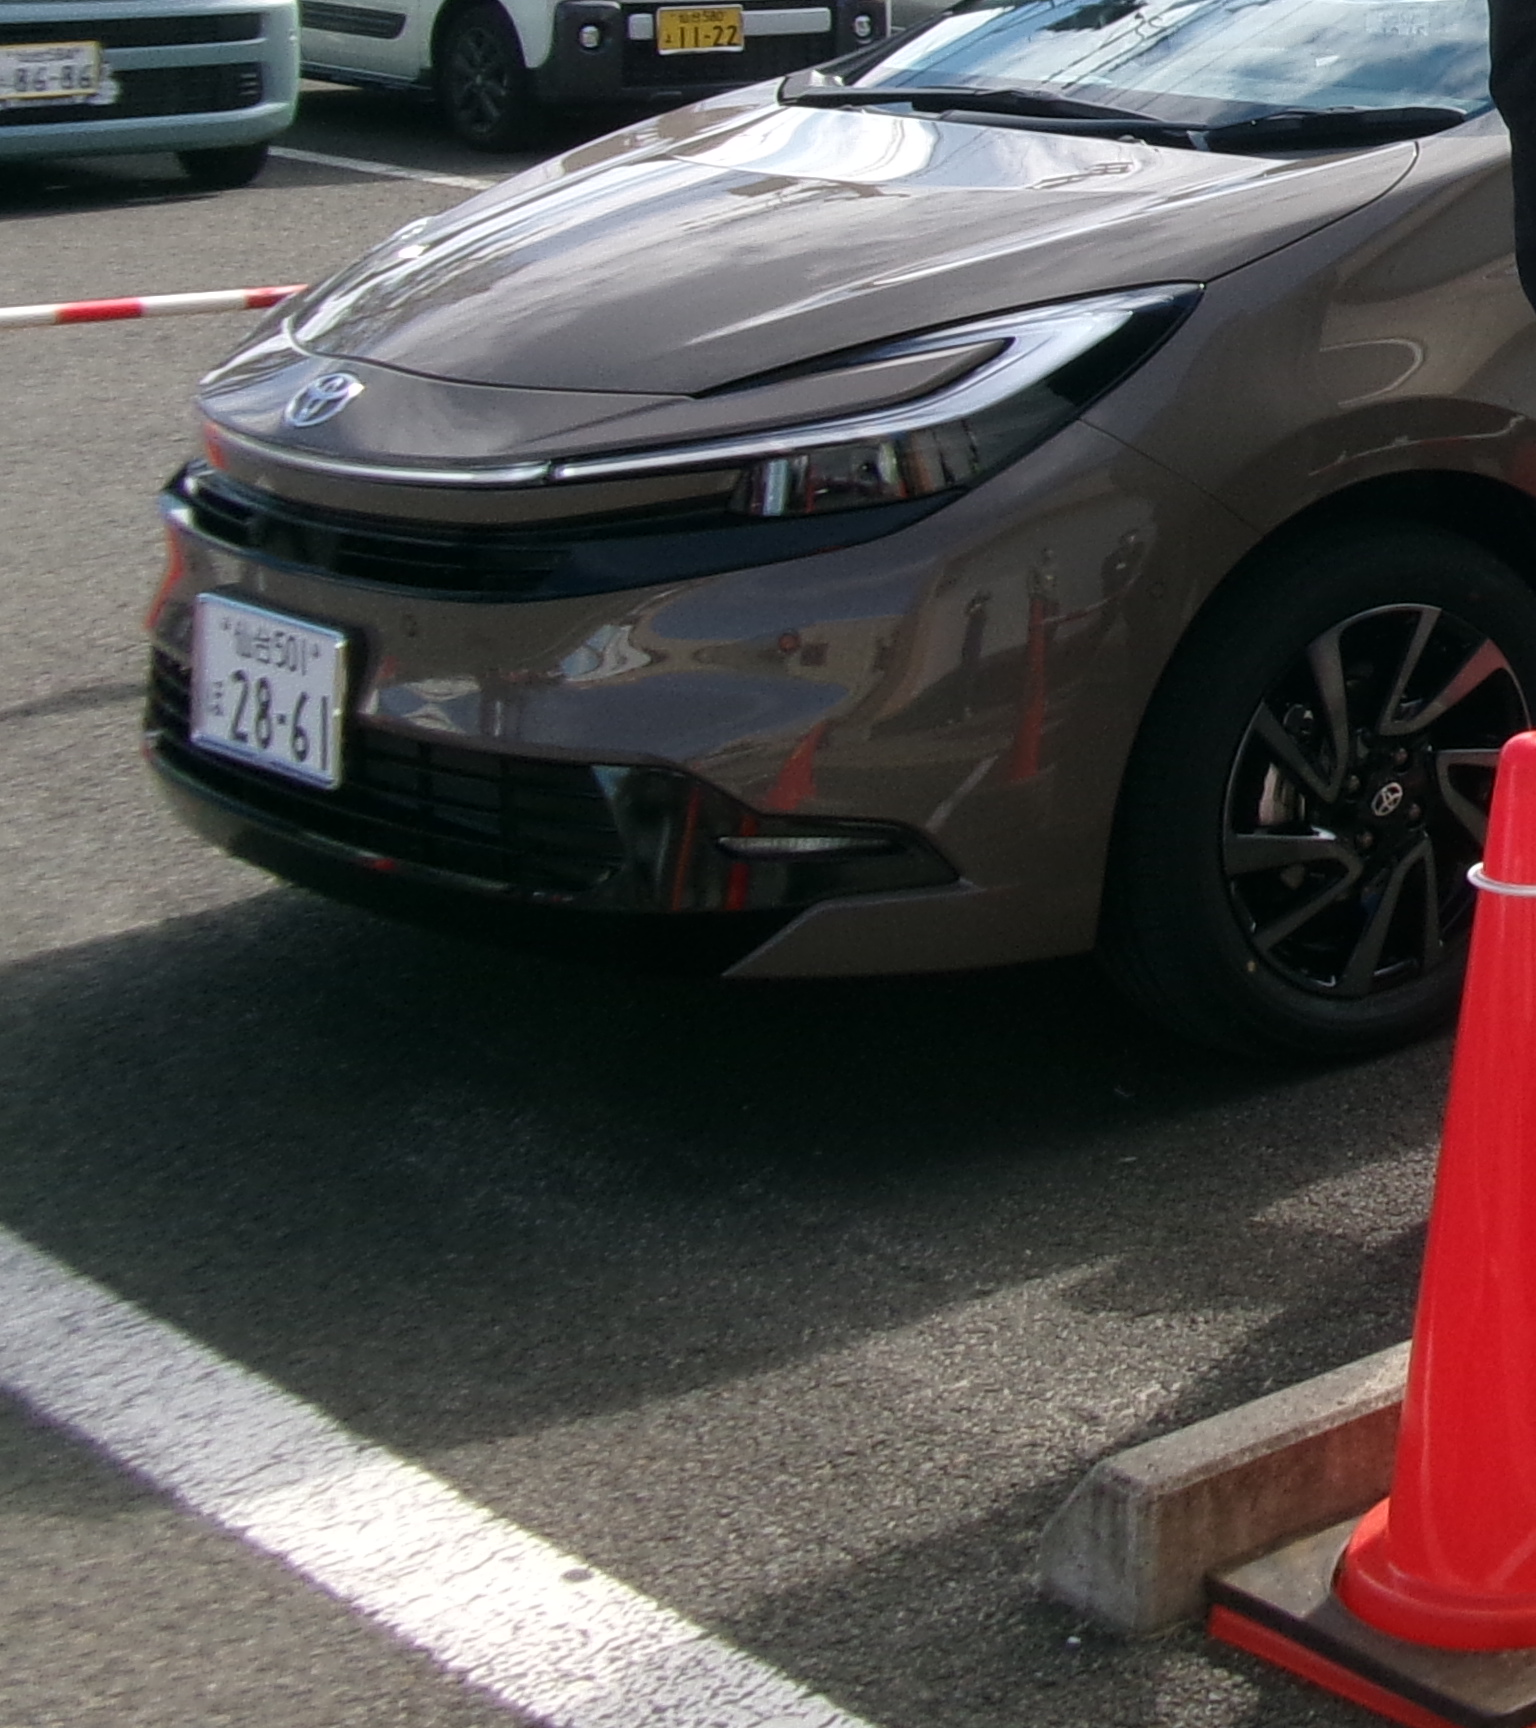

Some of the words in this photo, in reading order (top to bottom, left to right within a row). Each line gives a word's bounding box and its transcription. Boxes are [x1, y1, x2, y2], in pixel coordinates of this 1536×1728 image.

[679, 24, 738, 49] 11-22
[13, 63, 93, 92] 86-86
[230, 669, 329, 771] 28-61
